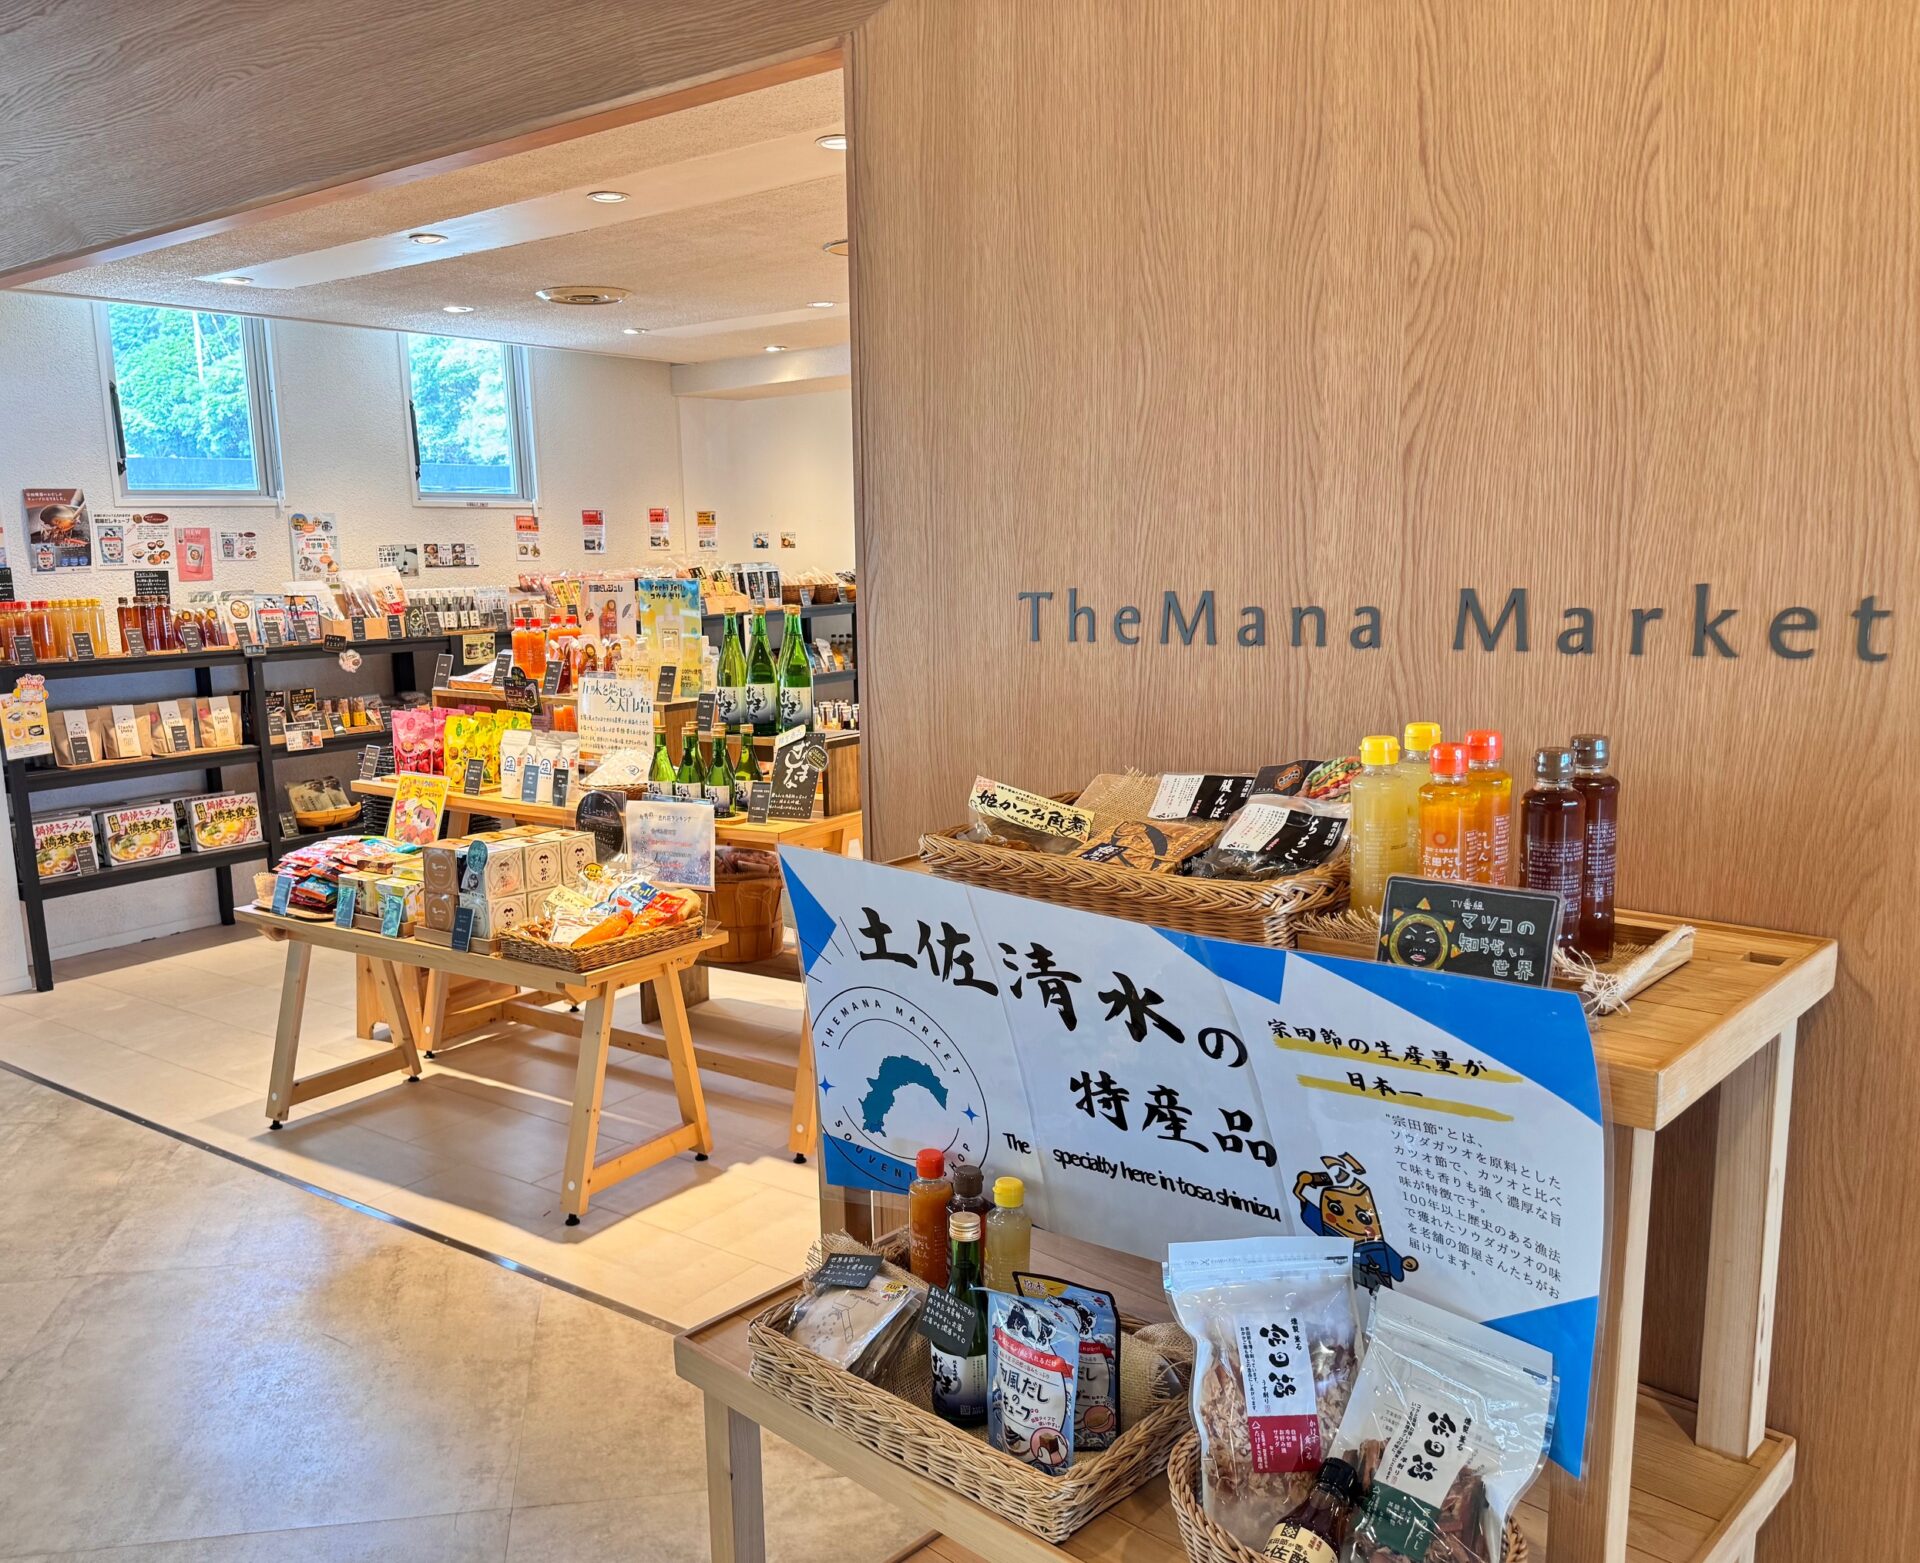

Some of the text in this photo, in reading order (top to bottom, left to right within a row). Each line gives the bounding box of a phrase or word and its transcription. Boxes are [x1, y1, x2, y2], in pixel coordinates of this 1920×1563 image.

[1451, 582, 1894, 664] Market
[119, 807, 167, 823] 鍋焼きラーメン
[206, 795, 251, 811] 鍋焼きラーメン
[213, 806, 258, 822] 橋本食堂
[977, 789, 1087, 832] 姫かつお角煮
[44, 830, 94, 848] 橋本食堂
[128, 817, 175, 834] 橋本食堂
[1284, 818, 1320, 861] ちちこ
[1451, 898, 1484, 911] TV番組
[1462, 912, 1536, 936] マツコの
[1458, 932, 1525, 958] 知らない
[858, 906, 1249, 1068] 土佐清水の
[1492, 959, 1534, 981] 世界
[821, 998, 961, 1075] THEMANA MARKET
[1267, 1018, 1488, 1077] 宗田節の生産量が
[1346, 1071, 1424, 1097] 日本一
[1069, 1070, 1278, 1168] 特産品
[835, 1119, 971, 1181] SOUVENI HOP
[1391, 1130, 1561, 1190] ソウダガツオを原料とした
[1002, 1132, 1282, 1223] The specialty here in tosa shimizu
[1394, 1145, 1562, 1207] カツオ節で、カツオと比べ
[1397, 1160, 1562, 1227] て味も香りも強く濃厚な旨
[1398, 1176, 1486, 1214] 味が特徴です。
[1402, 1191, 1561, 1264] 100年以上歴史のある漁法
[1404, 1207, 1562, 1283] で獲れたソウダガツオの味
[1407, 1222, 1560, 1299] を老舗の節屋さんたちがお
[1408, 1237, 1477, 1276] 届けします。
[1011, 1393, 1020, 1405] の
